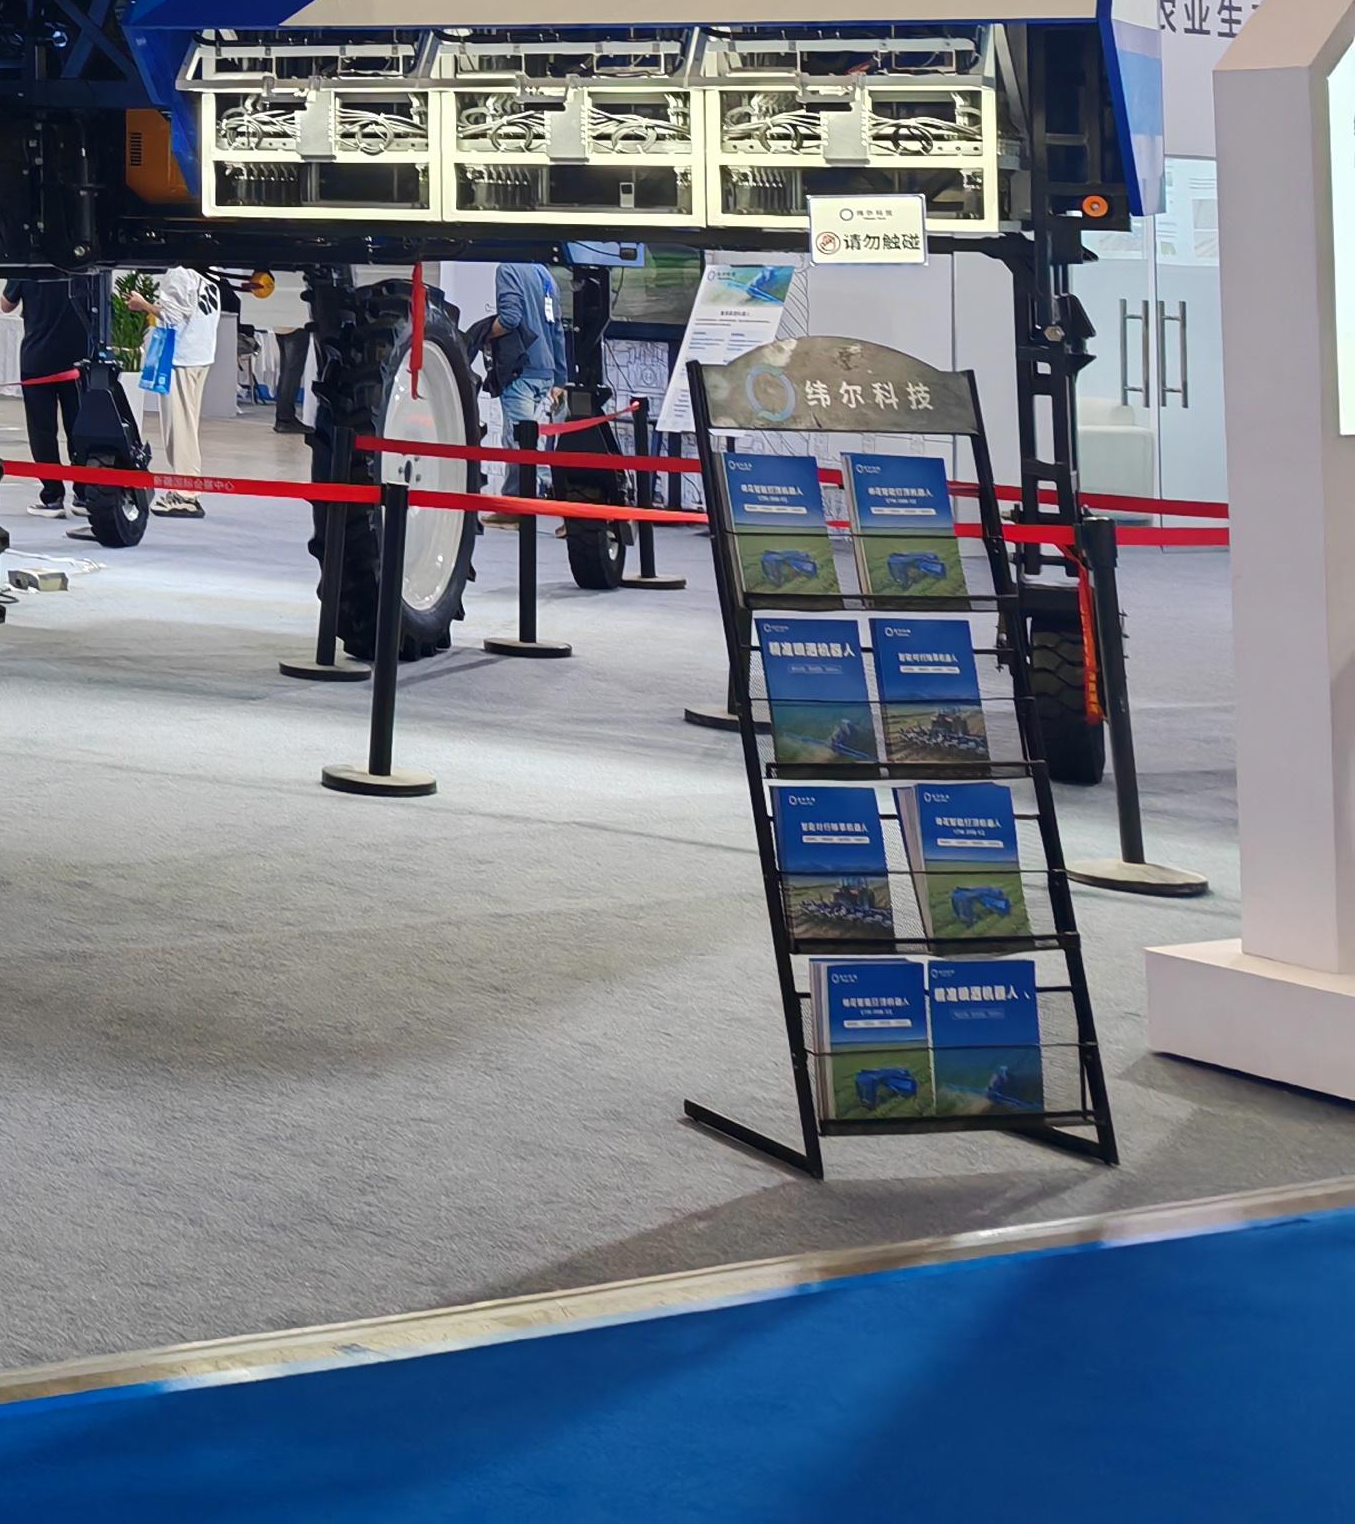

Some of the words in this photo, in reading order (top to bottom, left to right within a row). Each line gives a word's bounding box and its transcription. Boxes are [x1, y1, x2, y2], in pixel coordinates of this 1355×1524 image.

[843, 233, 921, 251] 请勿触碰
[804, 379, 934, 411] 纬尔科技
